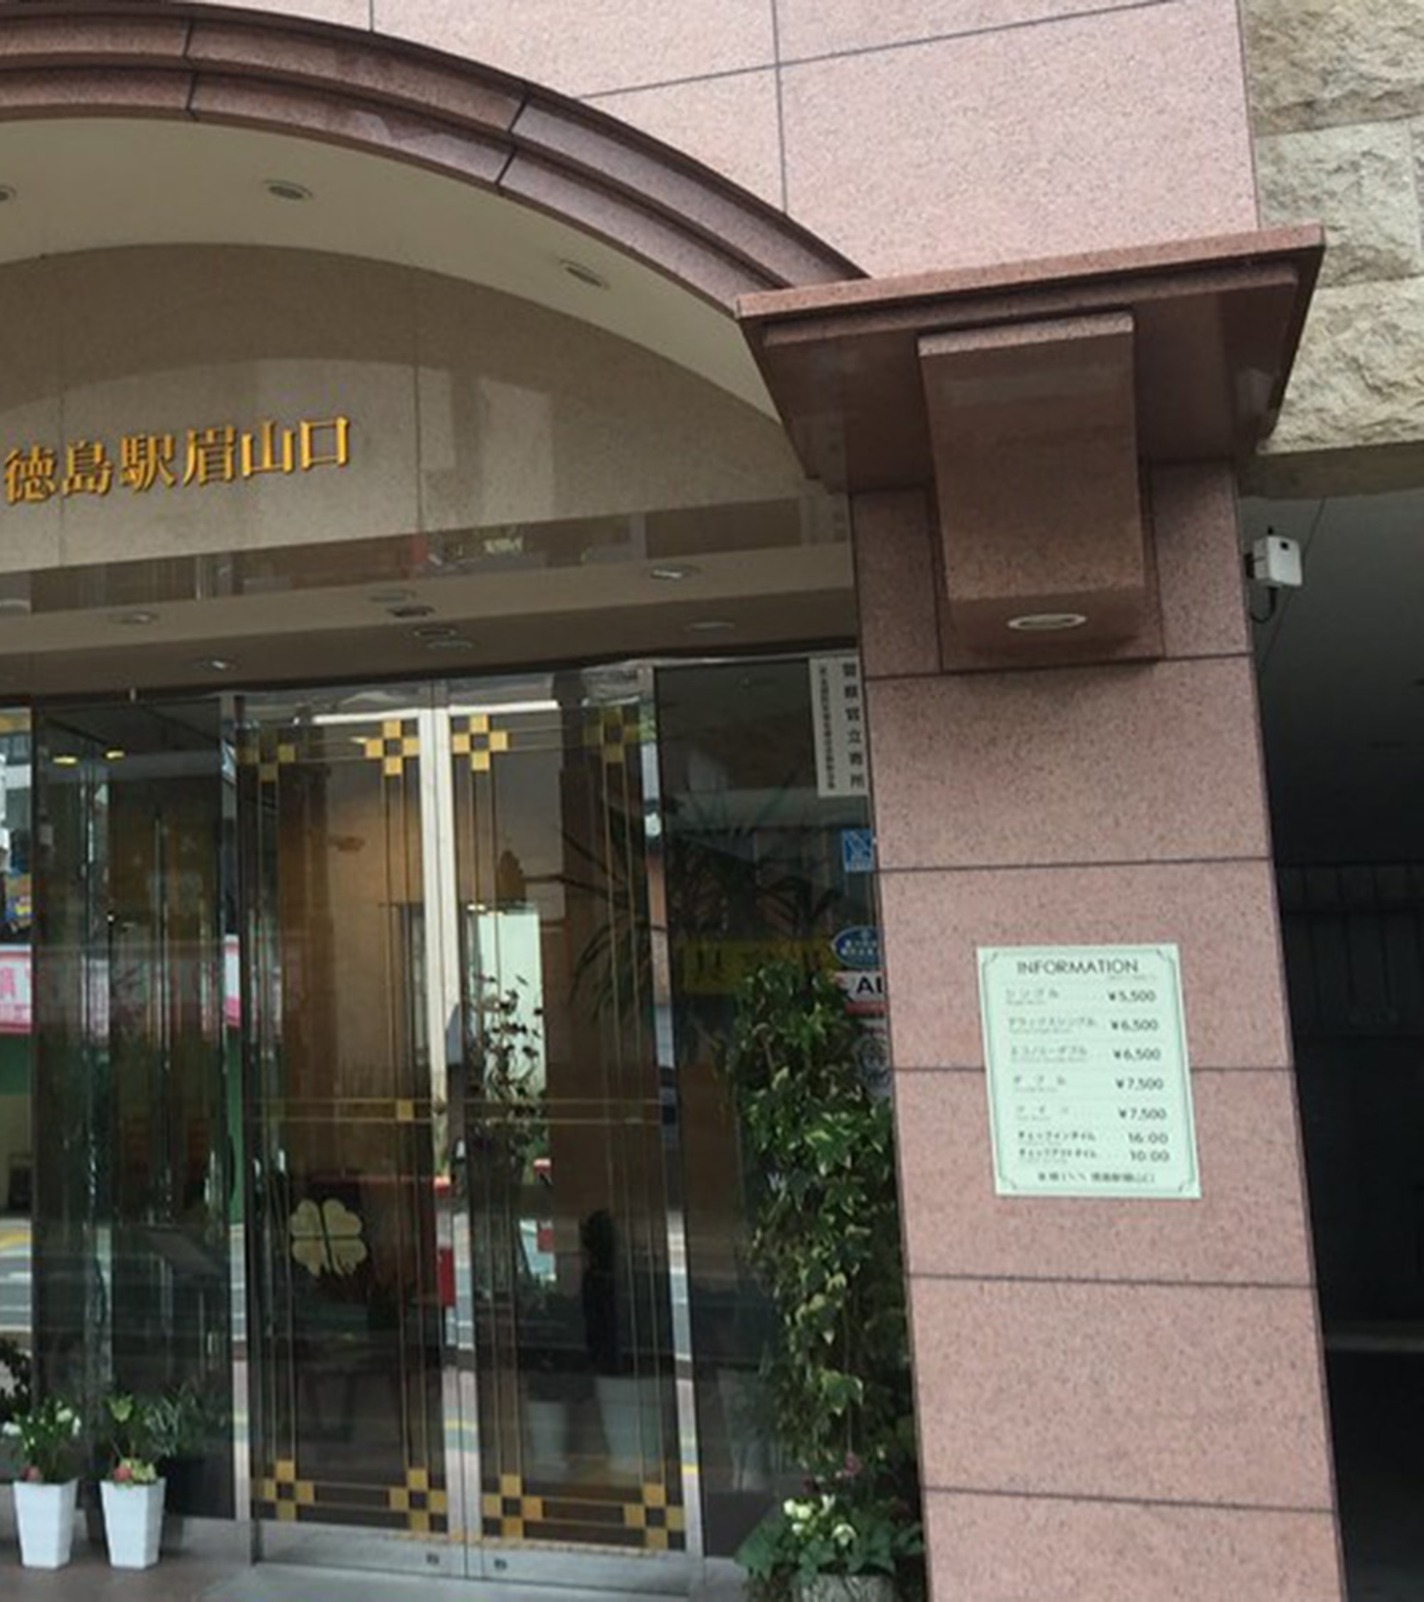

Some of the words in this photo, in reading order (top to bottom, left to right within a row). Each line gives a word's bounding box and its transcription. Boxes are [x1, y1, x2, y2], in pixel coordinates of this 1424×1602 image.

[1017, 958, 1140, 976] INFORMATION
[1108, 989, 1157, 1002] ¥5,500
[1115, 1076, 1164, 1091] ¥7,500
[1118, 1107, 1167, 1121] ¥7,500
